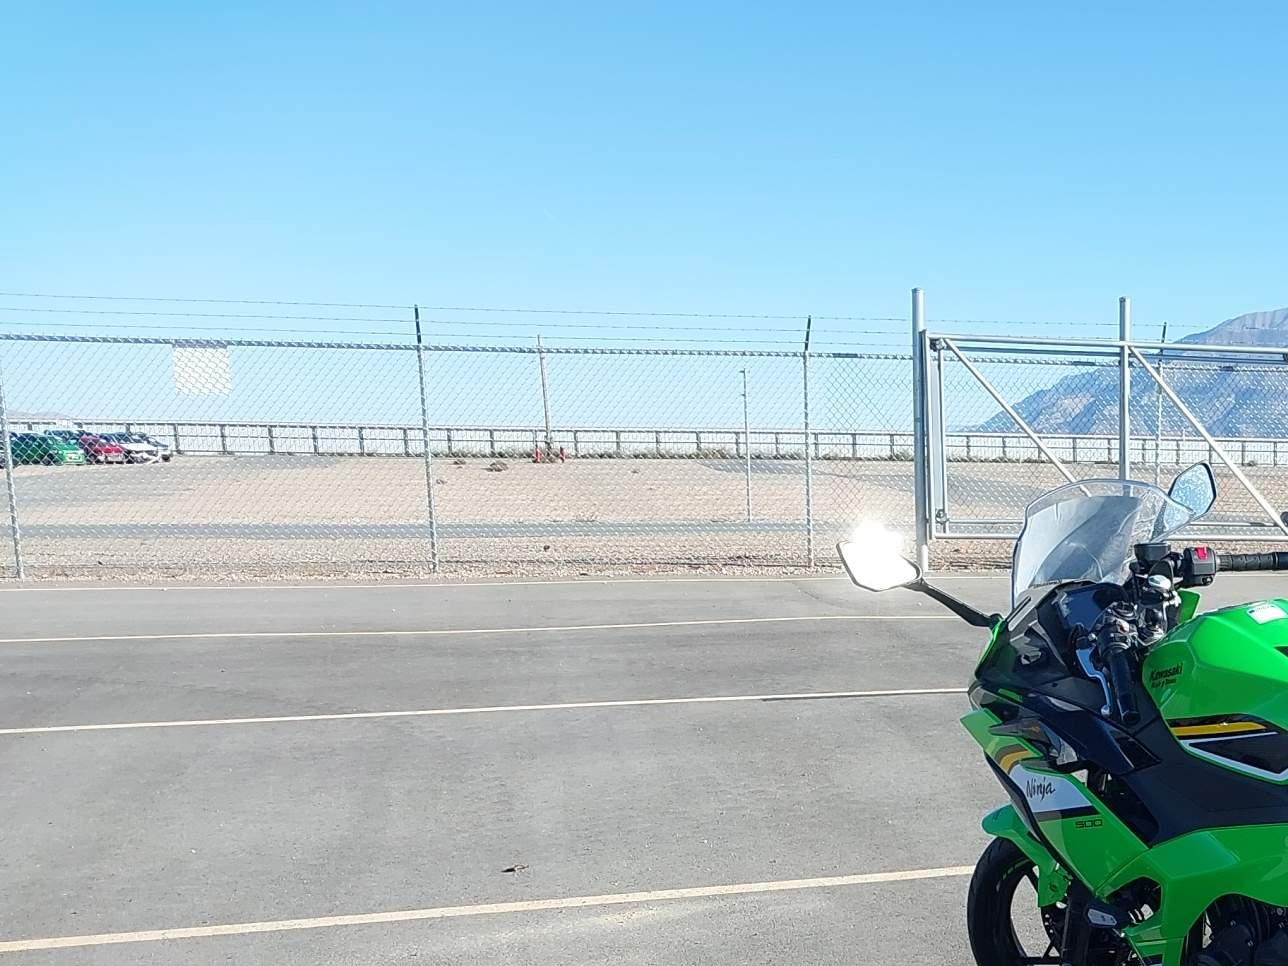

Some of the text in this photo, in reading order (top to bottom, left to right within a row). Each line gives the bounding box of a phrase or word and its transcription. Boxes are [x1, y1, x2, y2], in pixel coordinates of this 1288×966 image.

[1151, 662, 1184, 681] Kawasaki
[1026, 777, 1056, 800] Ninja
[1075, 819, 1104, 829] 500
